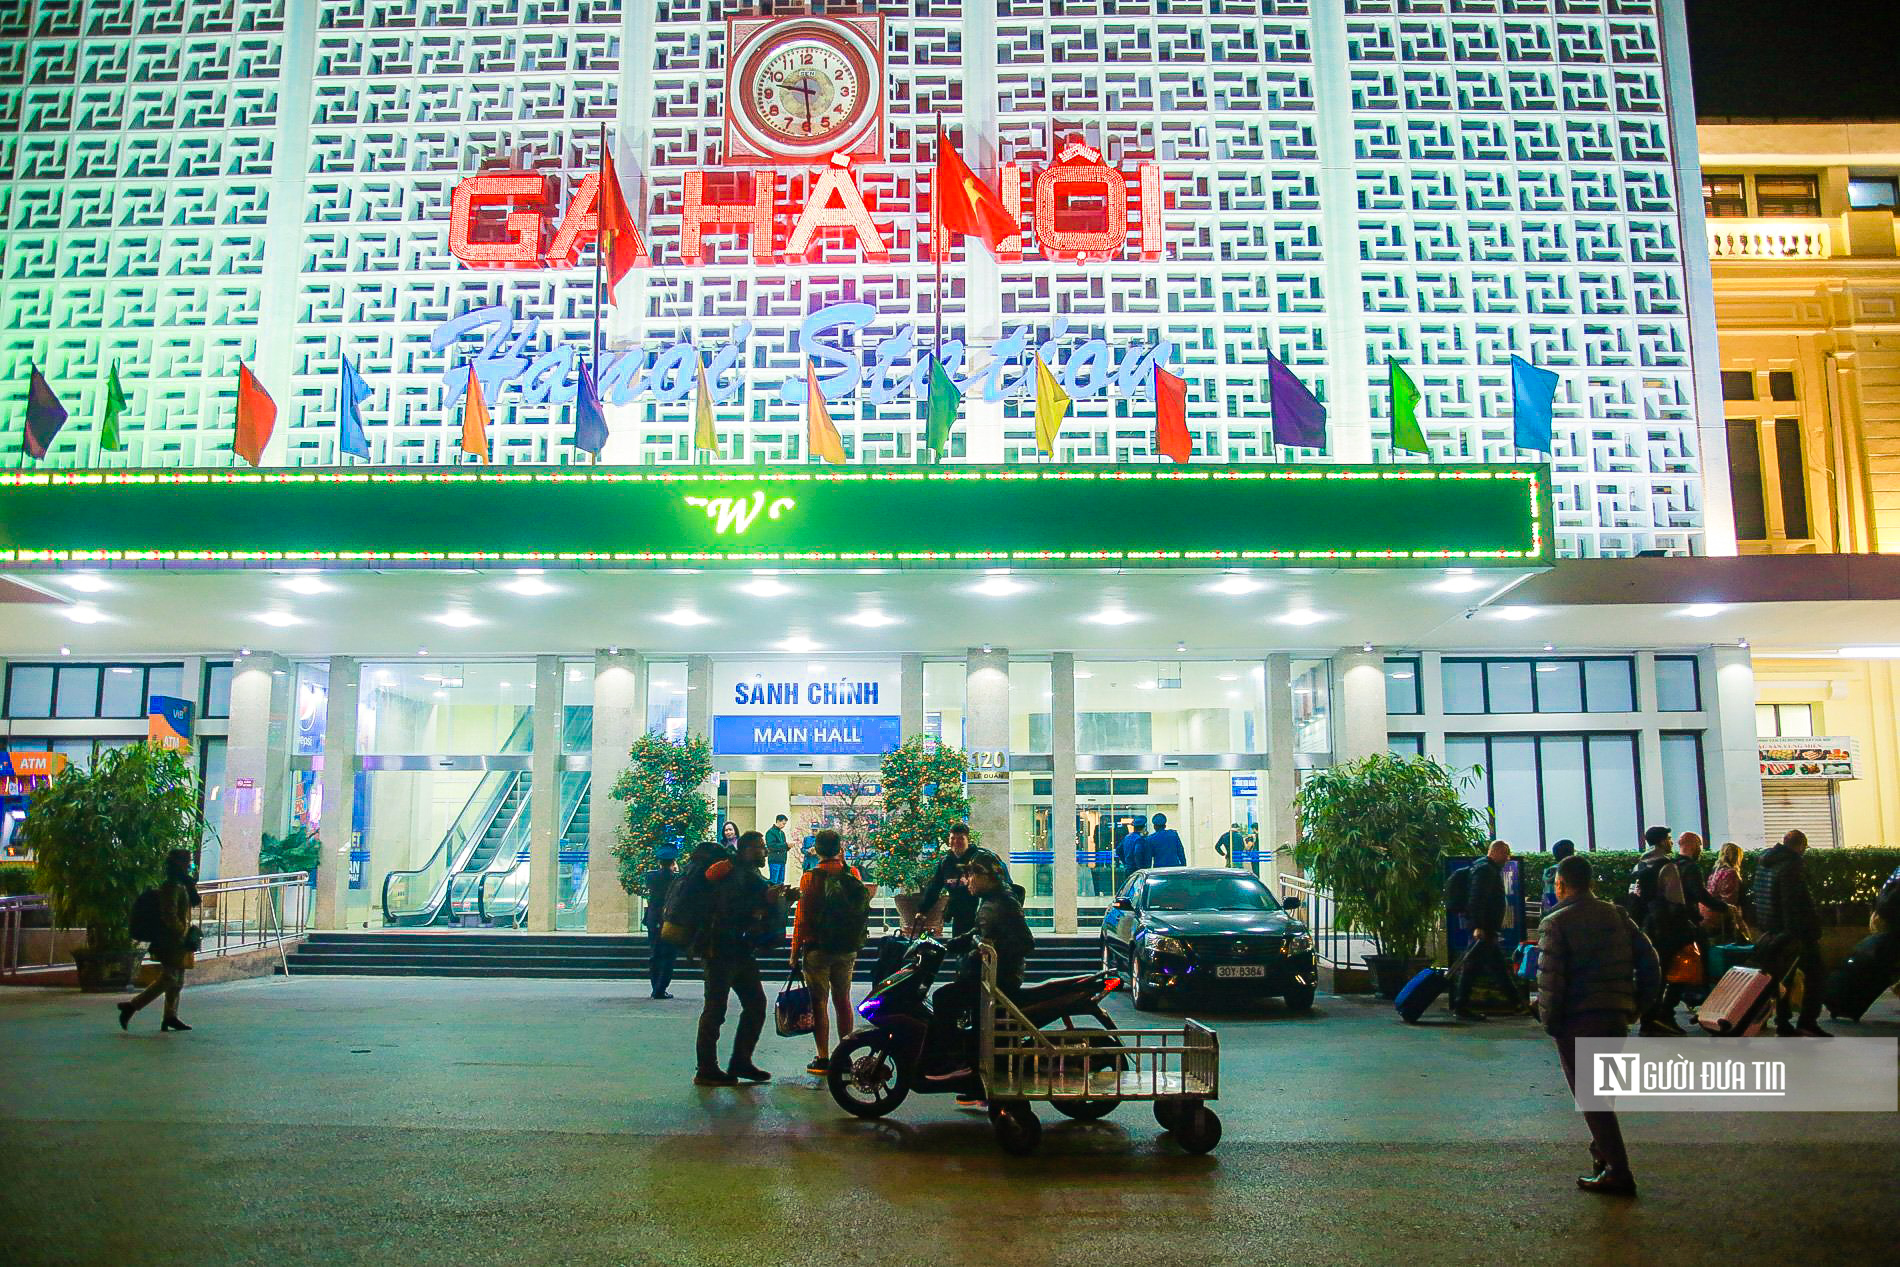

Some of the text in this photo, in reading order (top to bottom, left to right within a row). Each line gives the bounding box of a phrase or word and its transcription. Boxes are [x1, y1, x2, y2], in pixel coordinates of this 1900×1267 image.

[783, 59, 794, 70] 11
[800, 53, 813, 65] 12
[823, 58, 828, 69] 1
[769, 71, 784, 82] 10
[834, 69, 844, 80] 2
[763, 88, 774, 99] 9
[840, 86, 850, 97] 3
[769, 104, 779, 116] 8
[833, 103, 844, 114] 4
[784, 117, 794, 129] 7
[820, 116, 830, 128] 5
[450, 172, 651, 267] GA
[681, 152, 890, 263] HÀ
[431, 302, 1185, 408] Hanoi Station
[735, 674, 879, 705] SẢNH CHÍNH
[753, 727, 861, 744] MAIN HALL
[162, 736, 180, 749] ATM
[19, 758, 48, 769] ATM
[971, 752, 1006, 768] 120
